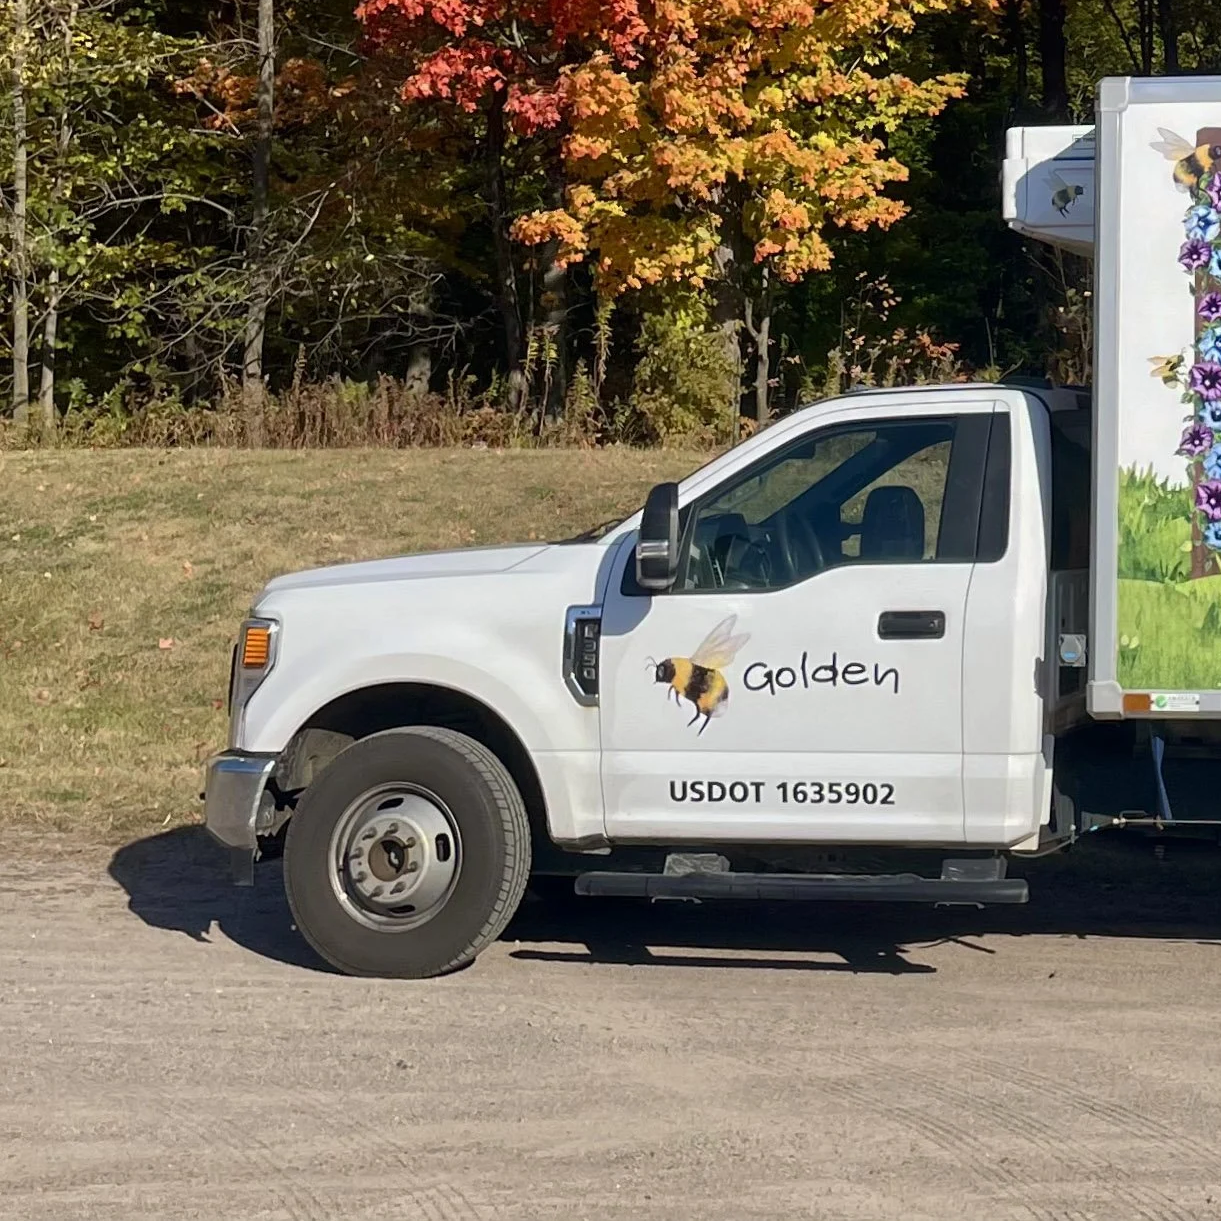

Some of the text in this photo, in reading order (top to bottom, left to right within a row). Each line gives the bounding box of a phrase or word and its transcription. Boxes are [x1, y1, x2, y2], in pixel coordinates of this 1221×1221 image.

[743, 651, 898, 696] Golden
[670, 781, 895, 806] USDOT 1635902
